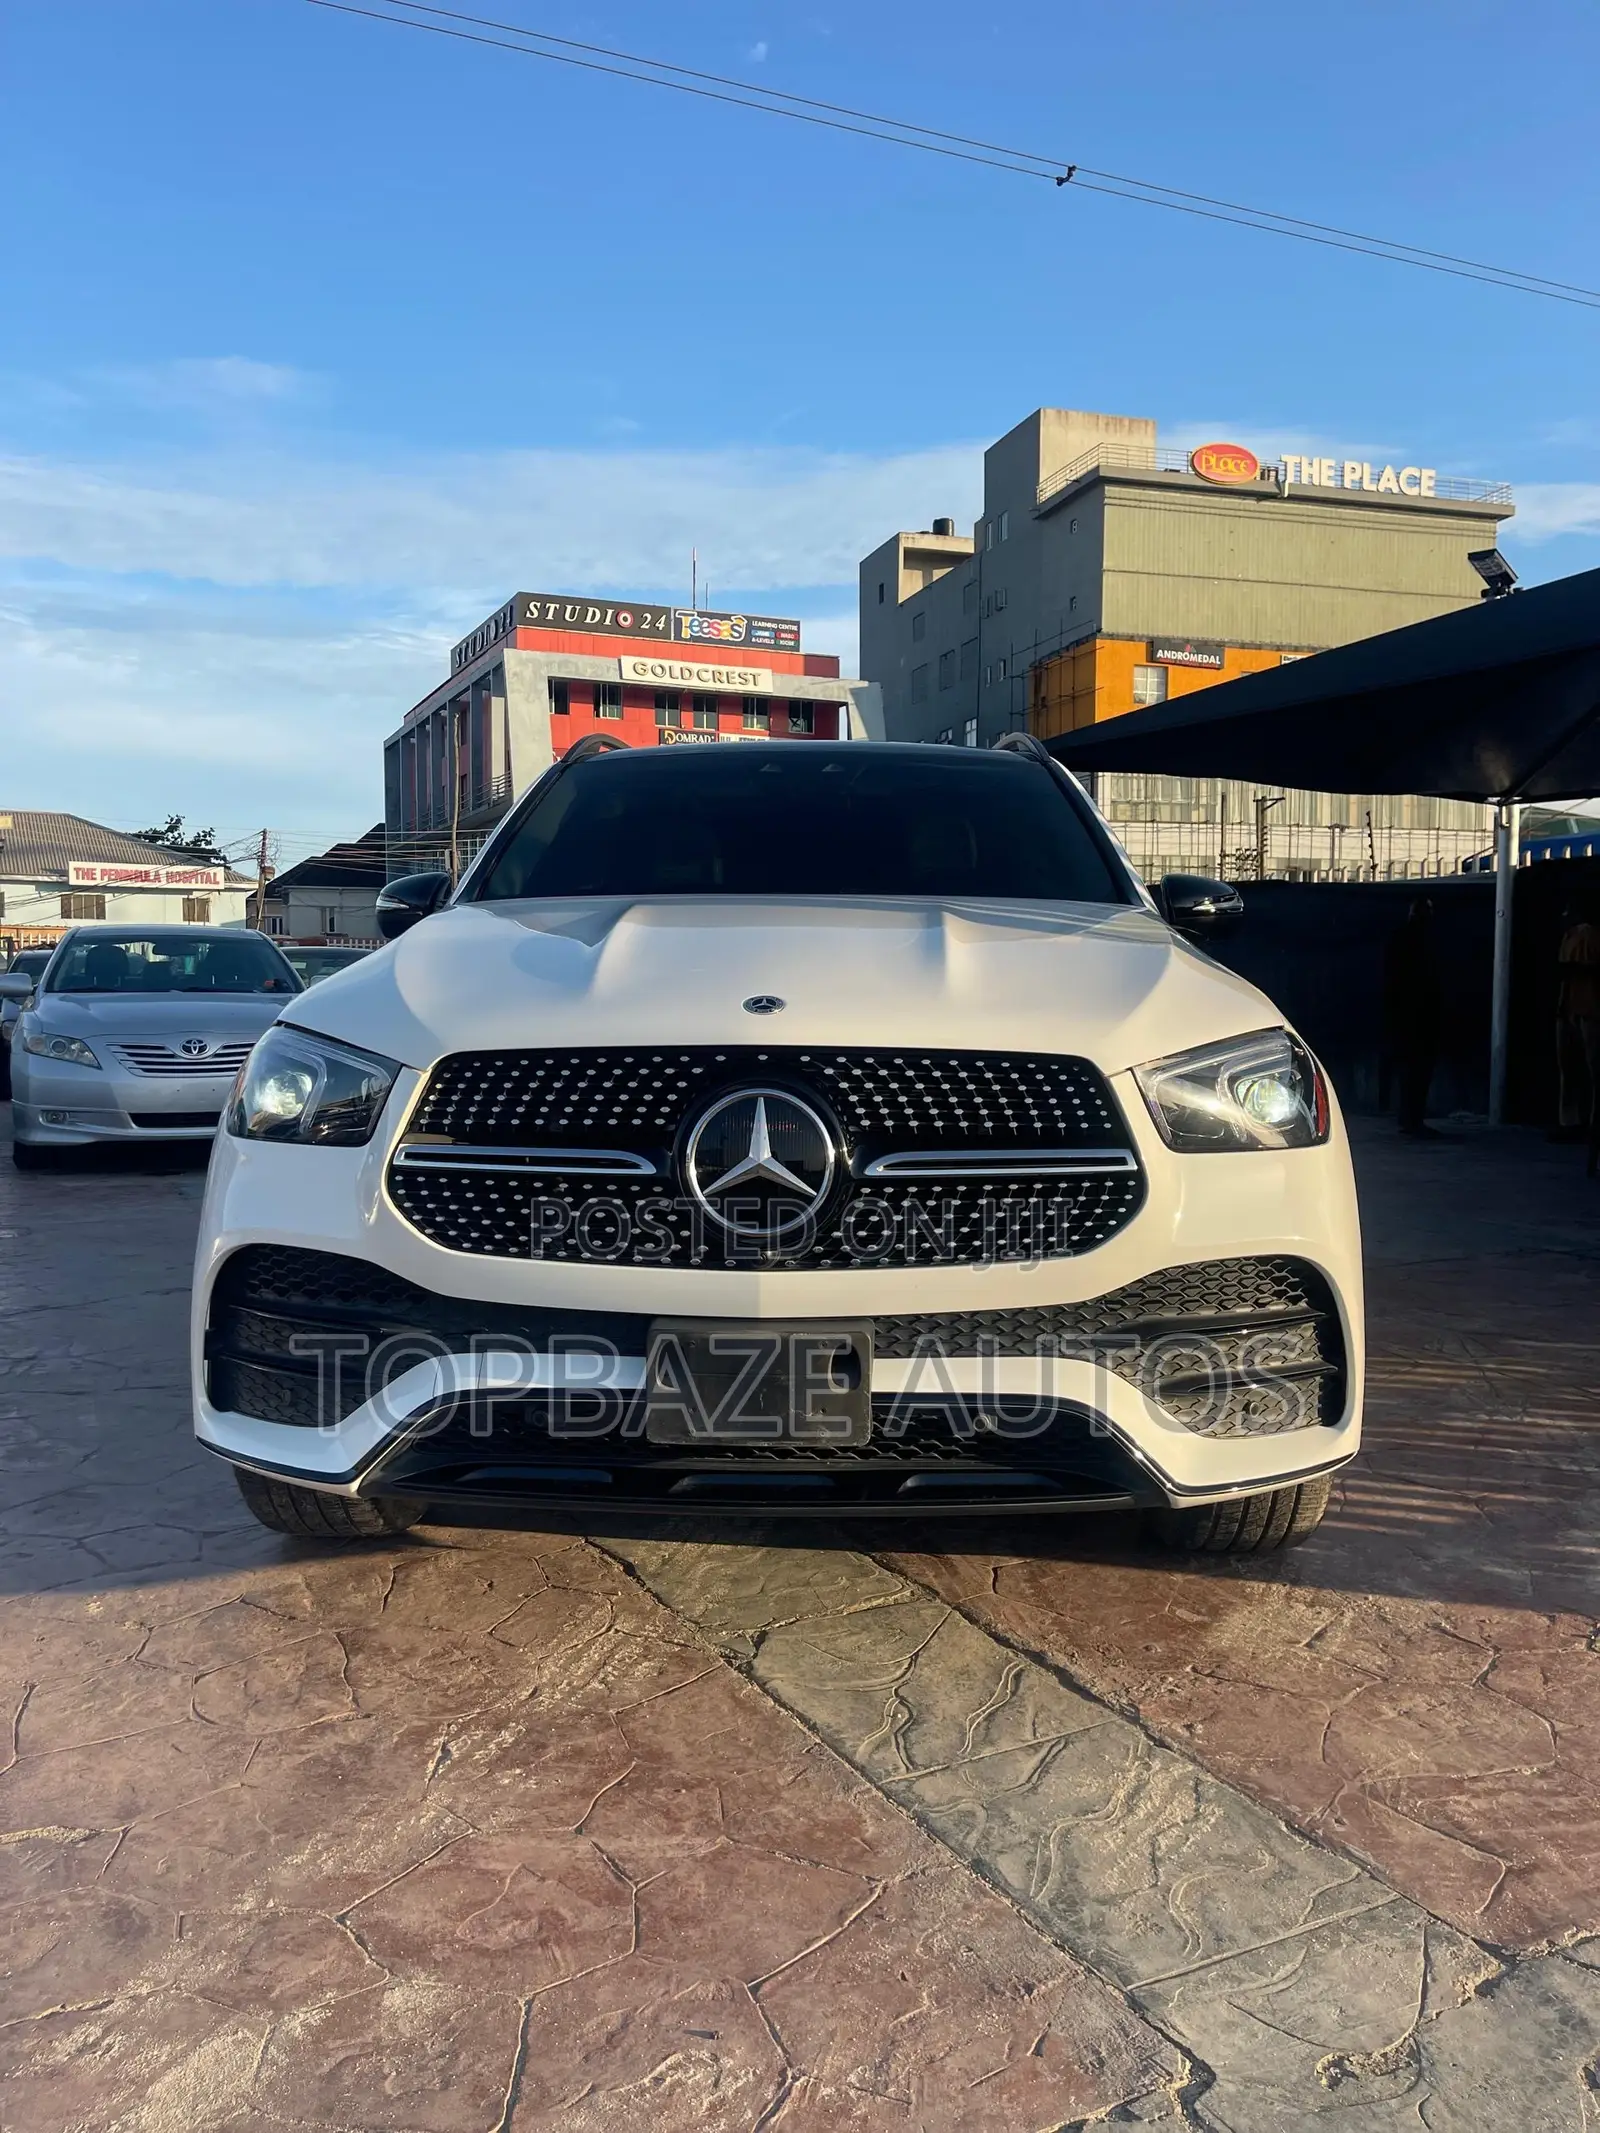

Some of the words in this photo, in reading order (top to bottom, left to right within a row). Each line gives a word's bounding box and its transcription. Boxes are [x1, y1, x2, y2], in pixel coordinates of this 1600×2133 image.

[1281, 455, 1335, 486] THE
[1344, 460, 1436, 497] PLACE
[526, 601, 634, 628] STUDIO
[640, 612, 667, 631] 24
[752, 620, 778, 629] LEARNING
[778, 623, 798, 631] CENTRE
[1156, 649, 1221, 665] ANDROMEDAL
[632, 661, 762, 687] GOLDCREST
[74, 867, 97, 881] THE
[165, 870, 220, 885] HOSPITAL
